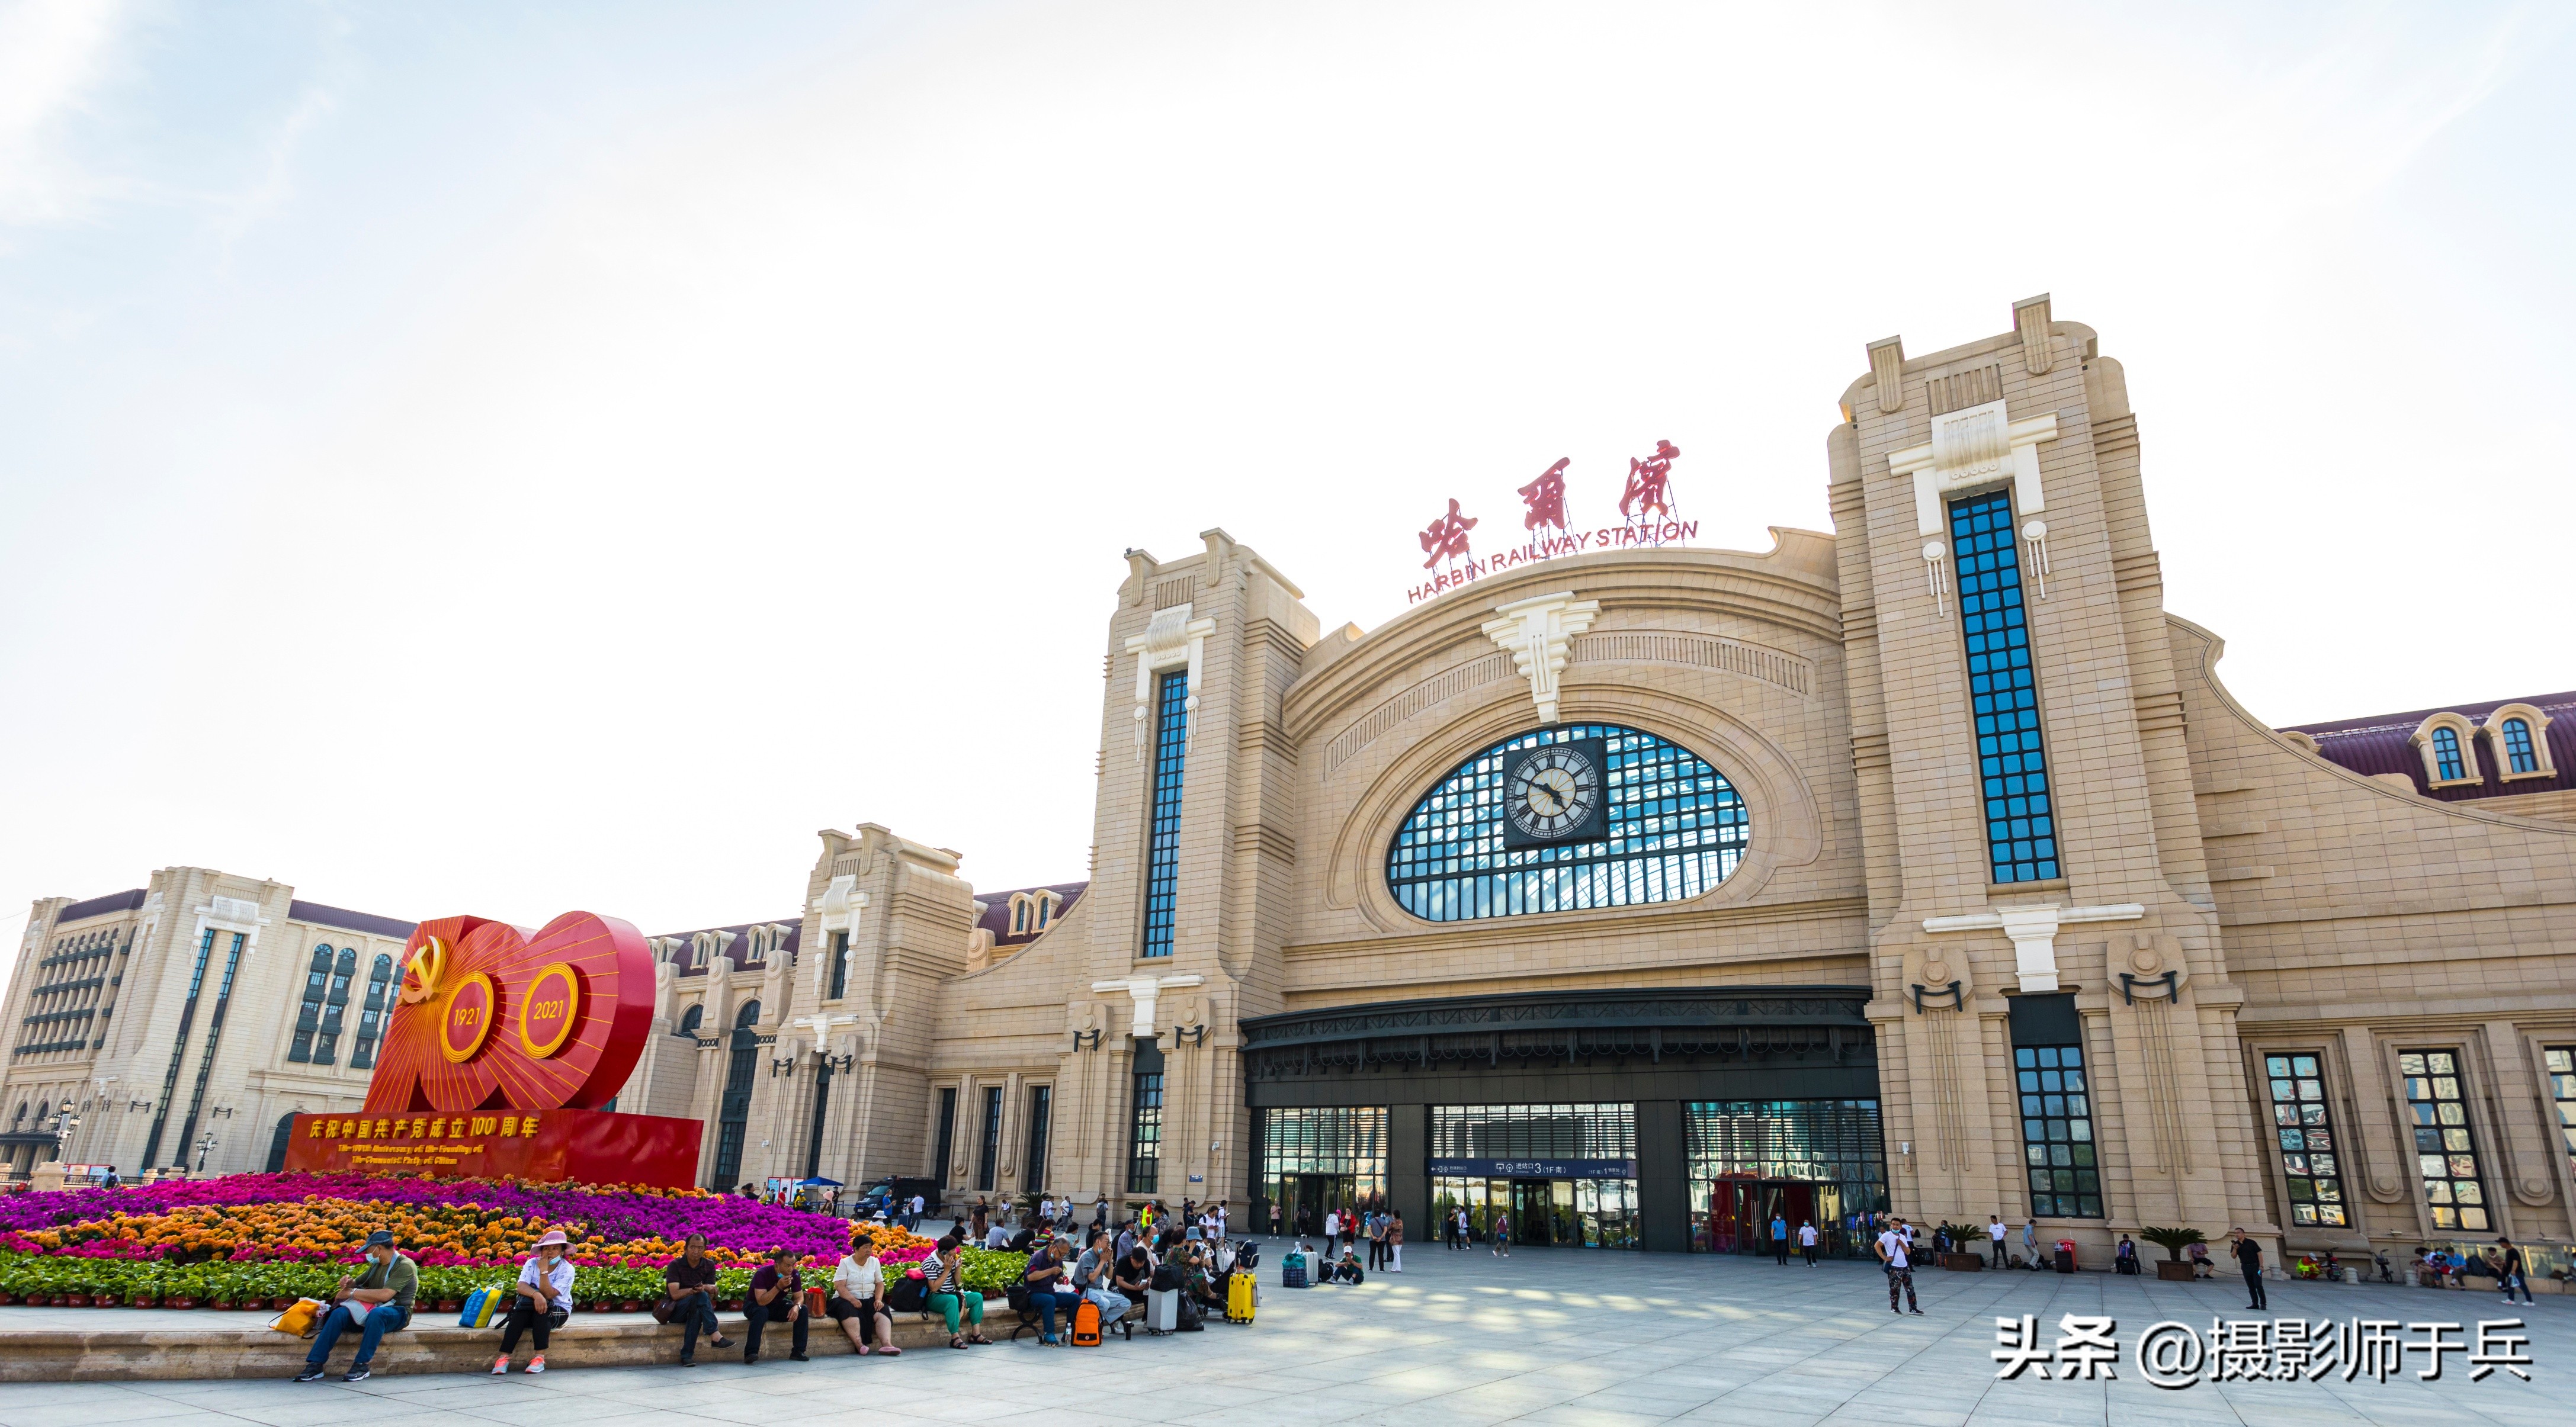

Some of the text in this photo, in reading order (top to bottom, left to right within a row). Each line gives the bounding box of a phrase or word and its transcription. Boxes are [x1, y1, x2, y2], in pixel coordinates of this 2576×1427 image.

[1408, 520, 1699, 604] HARBIN RAILWAY STATION
[453, 1007, 481, 1027] 1921
[534, 999, 564, 1021] 2021
[309, 1116, 540, 1139] 庆祝中国共产党成立100周年
[1535, 1163, 1541, 1174] 3
